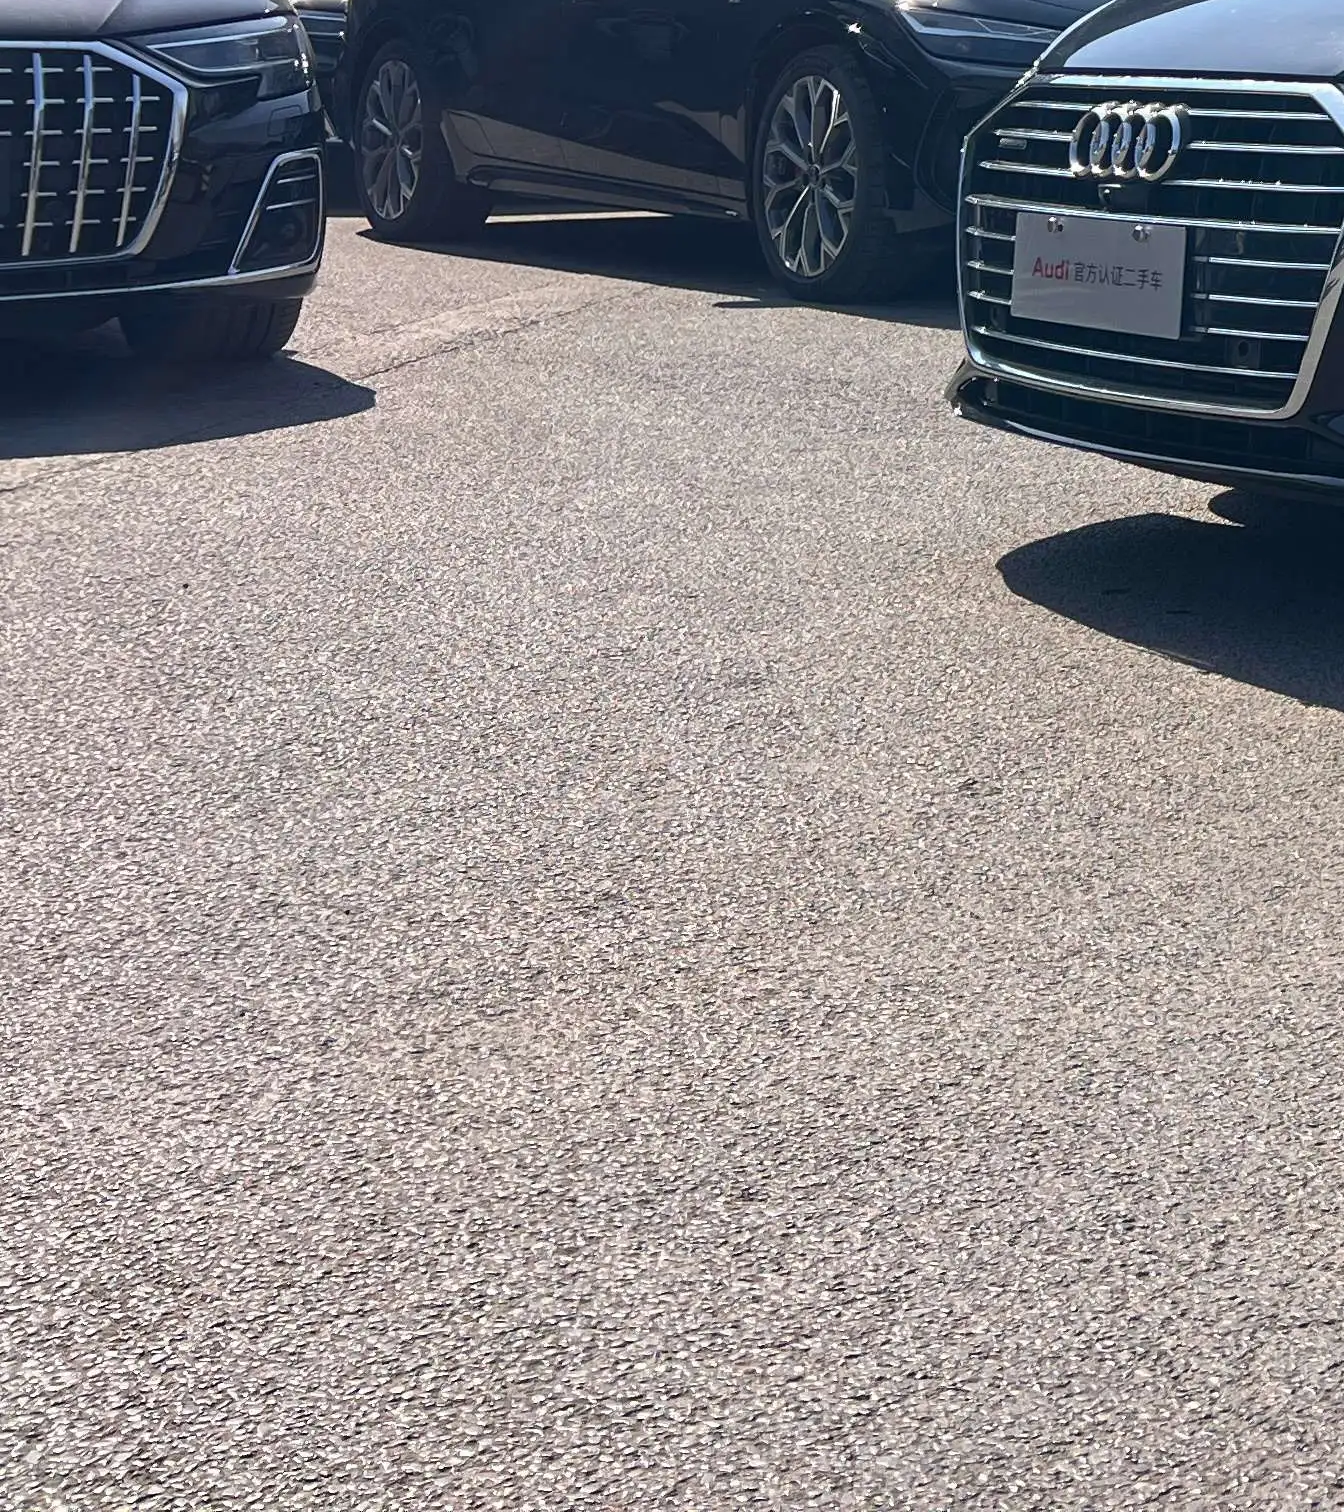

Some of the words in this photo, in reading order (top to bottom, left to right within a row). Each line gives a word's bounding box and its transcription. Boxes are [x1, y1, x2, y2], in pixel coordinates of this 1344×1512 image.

[1032, 257, 1070, 280] Audi
[1074, 262, 1163, 291] 官方认证二手车
